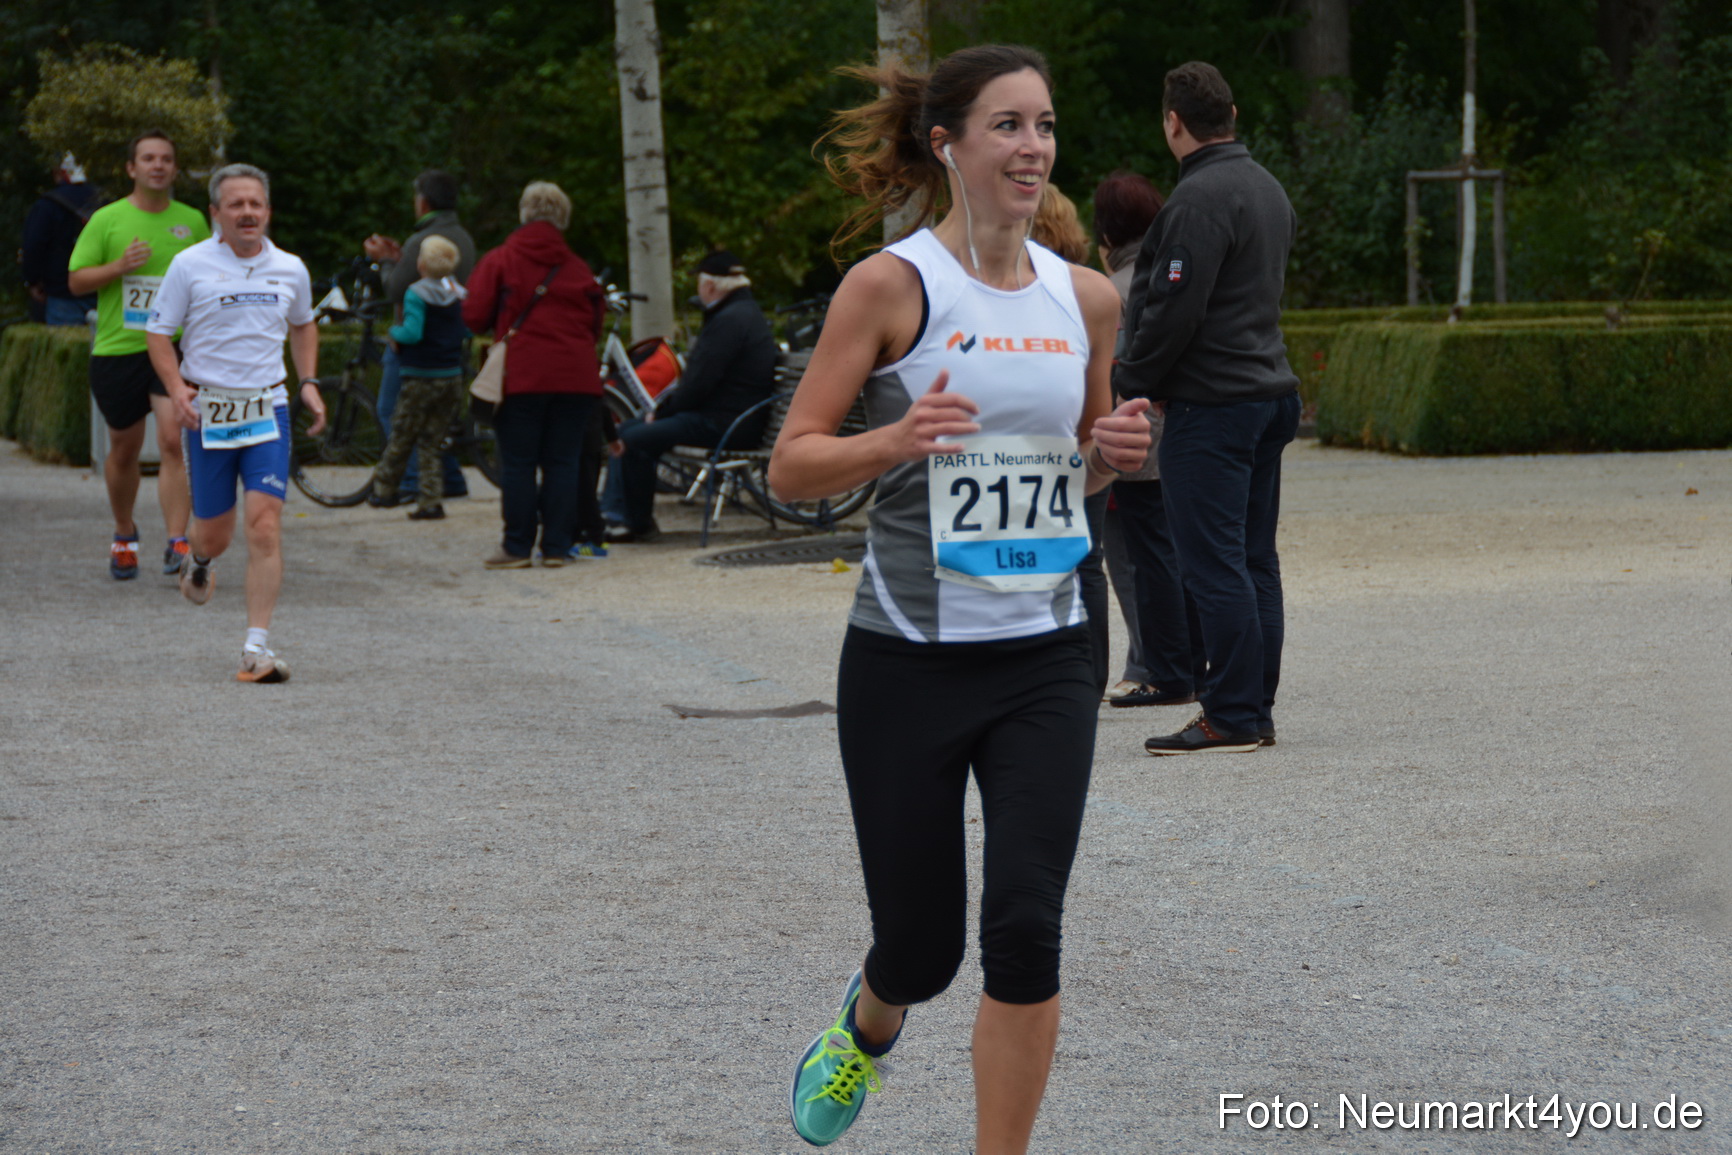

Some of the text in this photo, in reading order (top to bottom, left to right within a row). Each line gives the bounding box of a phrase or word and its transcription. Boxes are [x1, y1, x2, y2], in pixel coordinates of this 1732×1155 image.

[983, 337, 1075, 355] KLEBL
[209, 398, 263, 423] 2271
[934, 452, 1062, 468] PARTL Neumarkt
[950, 475, 1073, 532] 2174
[996, 547, 1037, 569] Lisa
